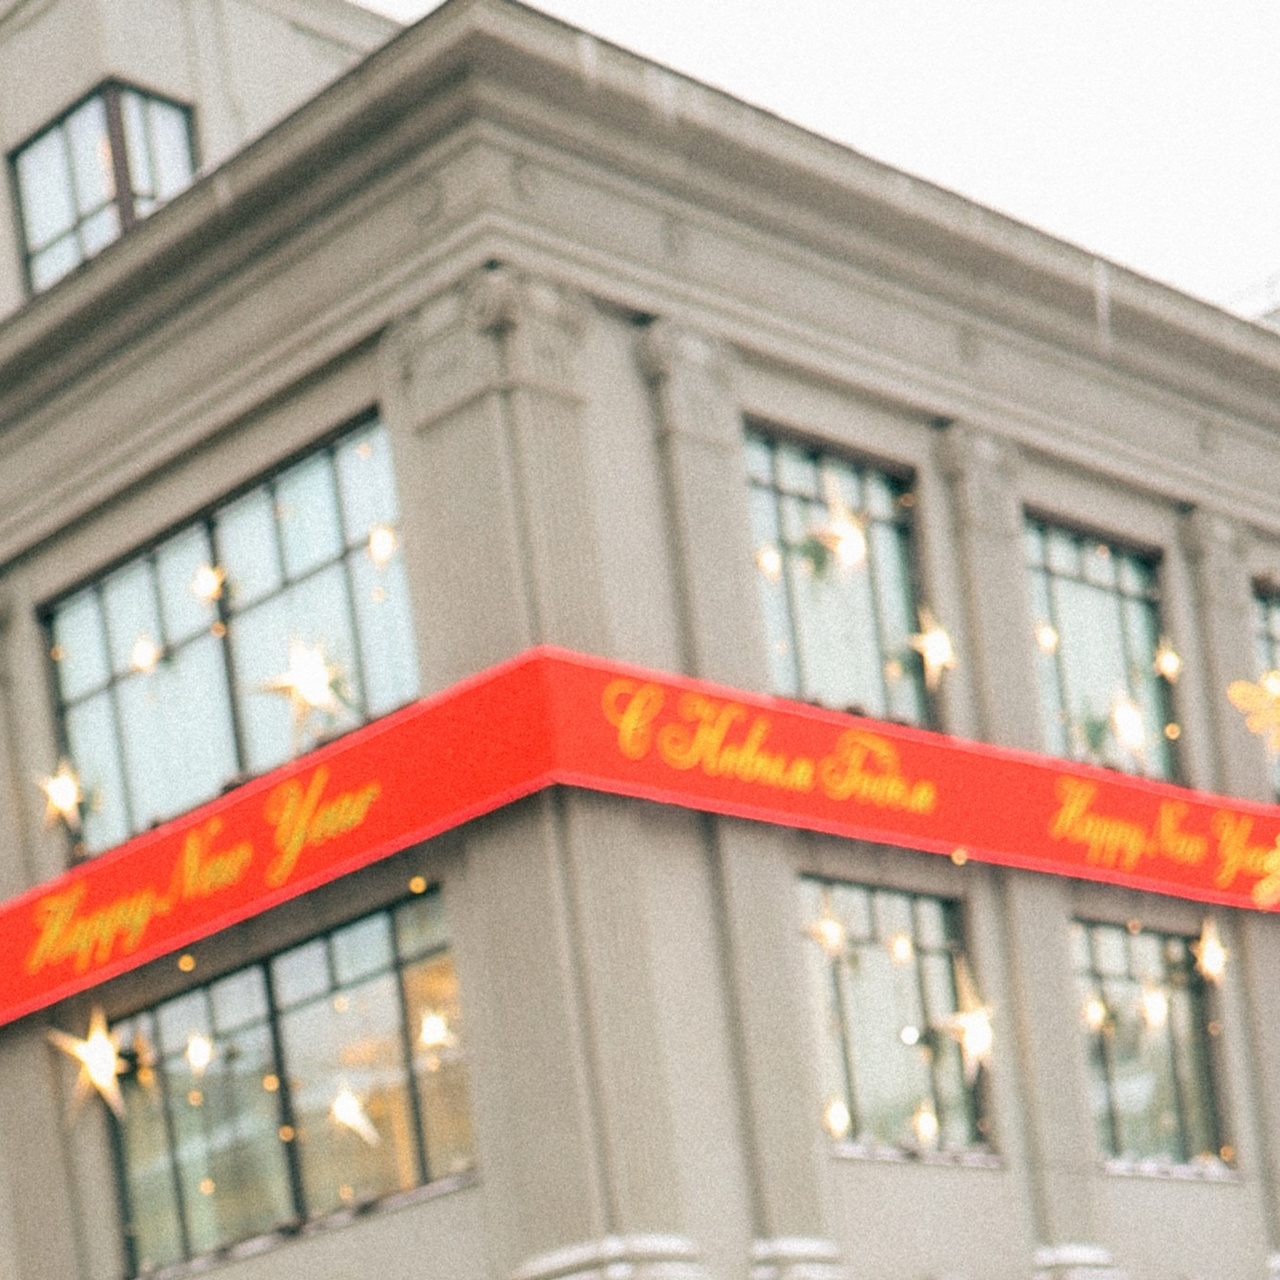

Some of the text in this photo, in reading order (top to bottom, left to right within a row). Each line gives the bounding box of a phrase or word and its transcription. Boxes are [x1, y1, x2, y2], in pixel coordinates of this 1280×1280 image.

[24, 764, 382, 976] Happy New Year
